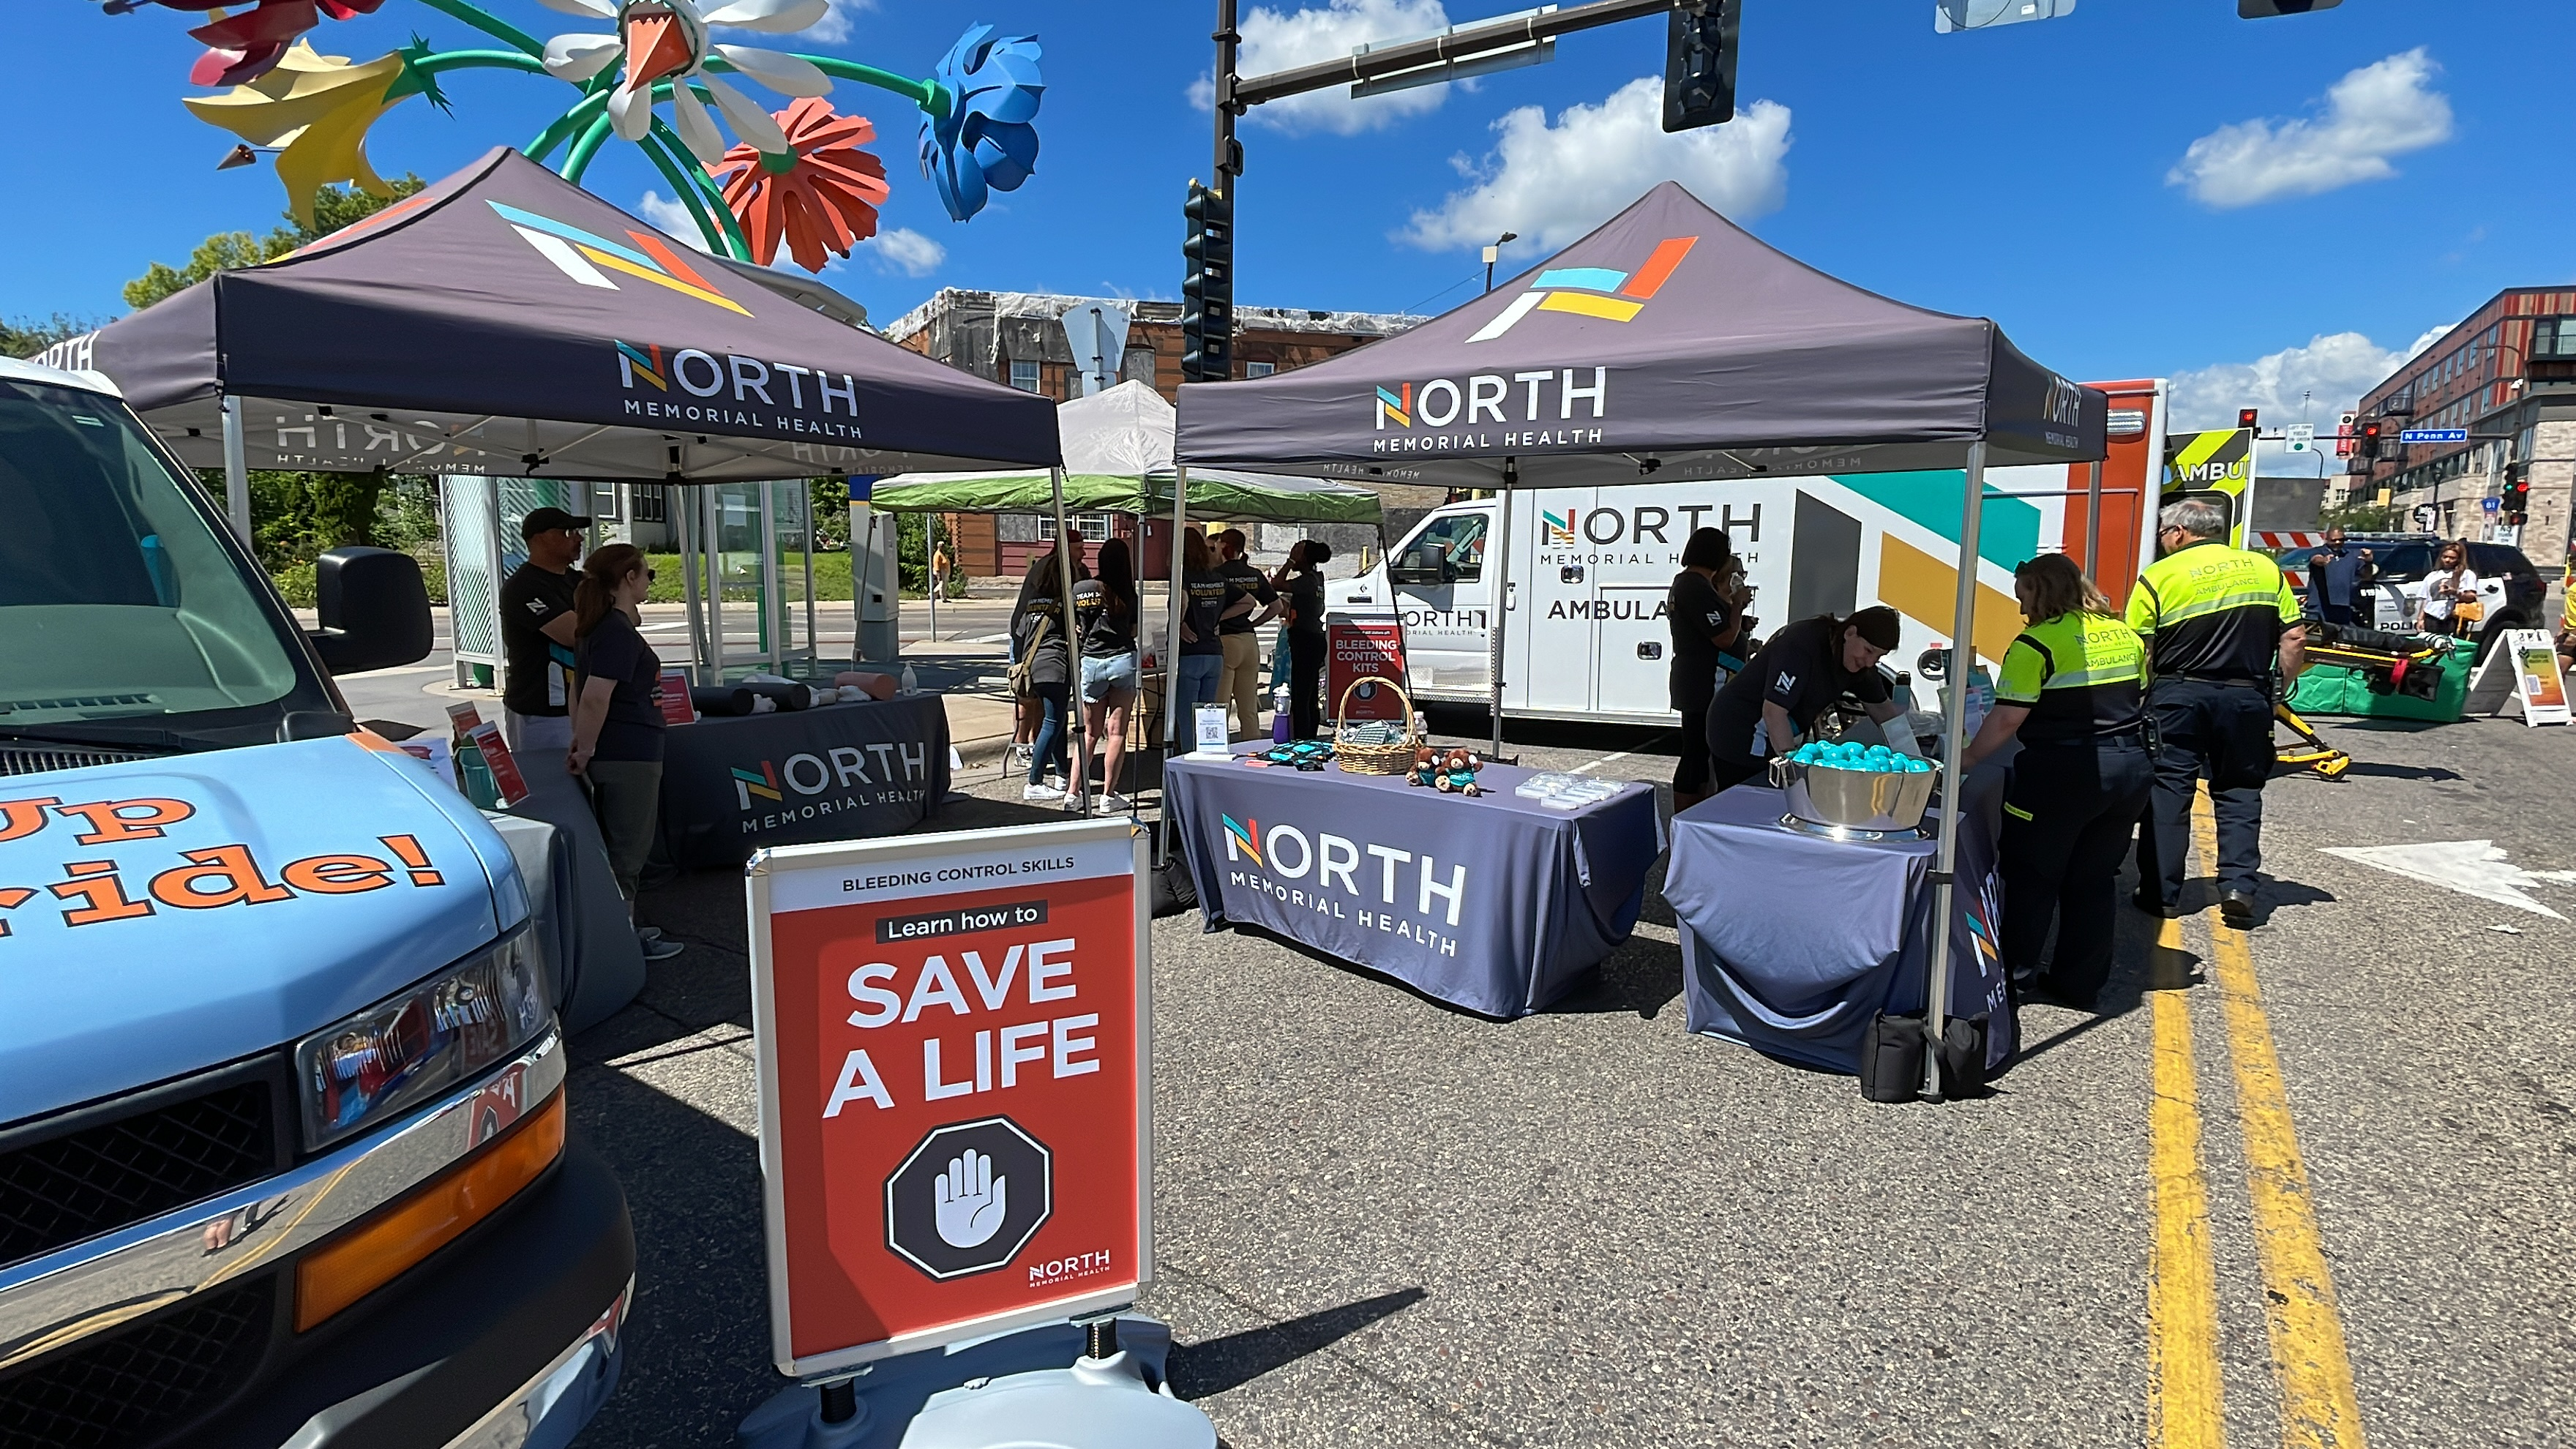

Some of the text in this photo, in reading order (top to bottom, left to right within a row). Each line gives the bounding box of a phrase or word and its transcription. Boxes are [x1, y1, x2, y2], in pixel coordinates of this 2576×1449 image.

[615, 339, 858, 416] NORTH
[1376, 366, 1606, 430] NORTH
[624, 400, 862, 438] MEMORIAL HEALTH
[1374, 427, 1603, 454] MEMORIAL HEALTH
[1541, 503, 1761, 545] NORTH
[1540, 554, 1654, 564] MEMORIAL
[2189, 559, 2253, 577] NORTH
[2195, 578, 2260, 596] AMBULANCE
[1407, 610, 1472, 626] ORTH
[1548, 600, 1669, 620] AMBULA
[2381, 622, 2417, 630] POLI
[1336, 640, 1397, 650] BLEEDING
[1336, 651, 1396, 662] CONTROL
[1352, 663, 1379, 673] KITS
[732, 741, 925, 810] NORTH
[742, 787, 926, 834] MEMORIAL HEALTH
[842, 857, 1074, 892] BLEEDING CONTROL SKILLS
[1221, 812, 1465, 927] NORTH
[888, 905, 1038, 939] Learn how to
[1231, 871, 1456, 957] MEMORIAL HEALTH
[846, 938, 1077, 1028] SAVE
[823, 1013, 1100, 1119] A LIFE
[1030, 1249, 1110, 1281] NORTH
[1030, 1266, 1110, 1287] MEMORIAL HEALTH
